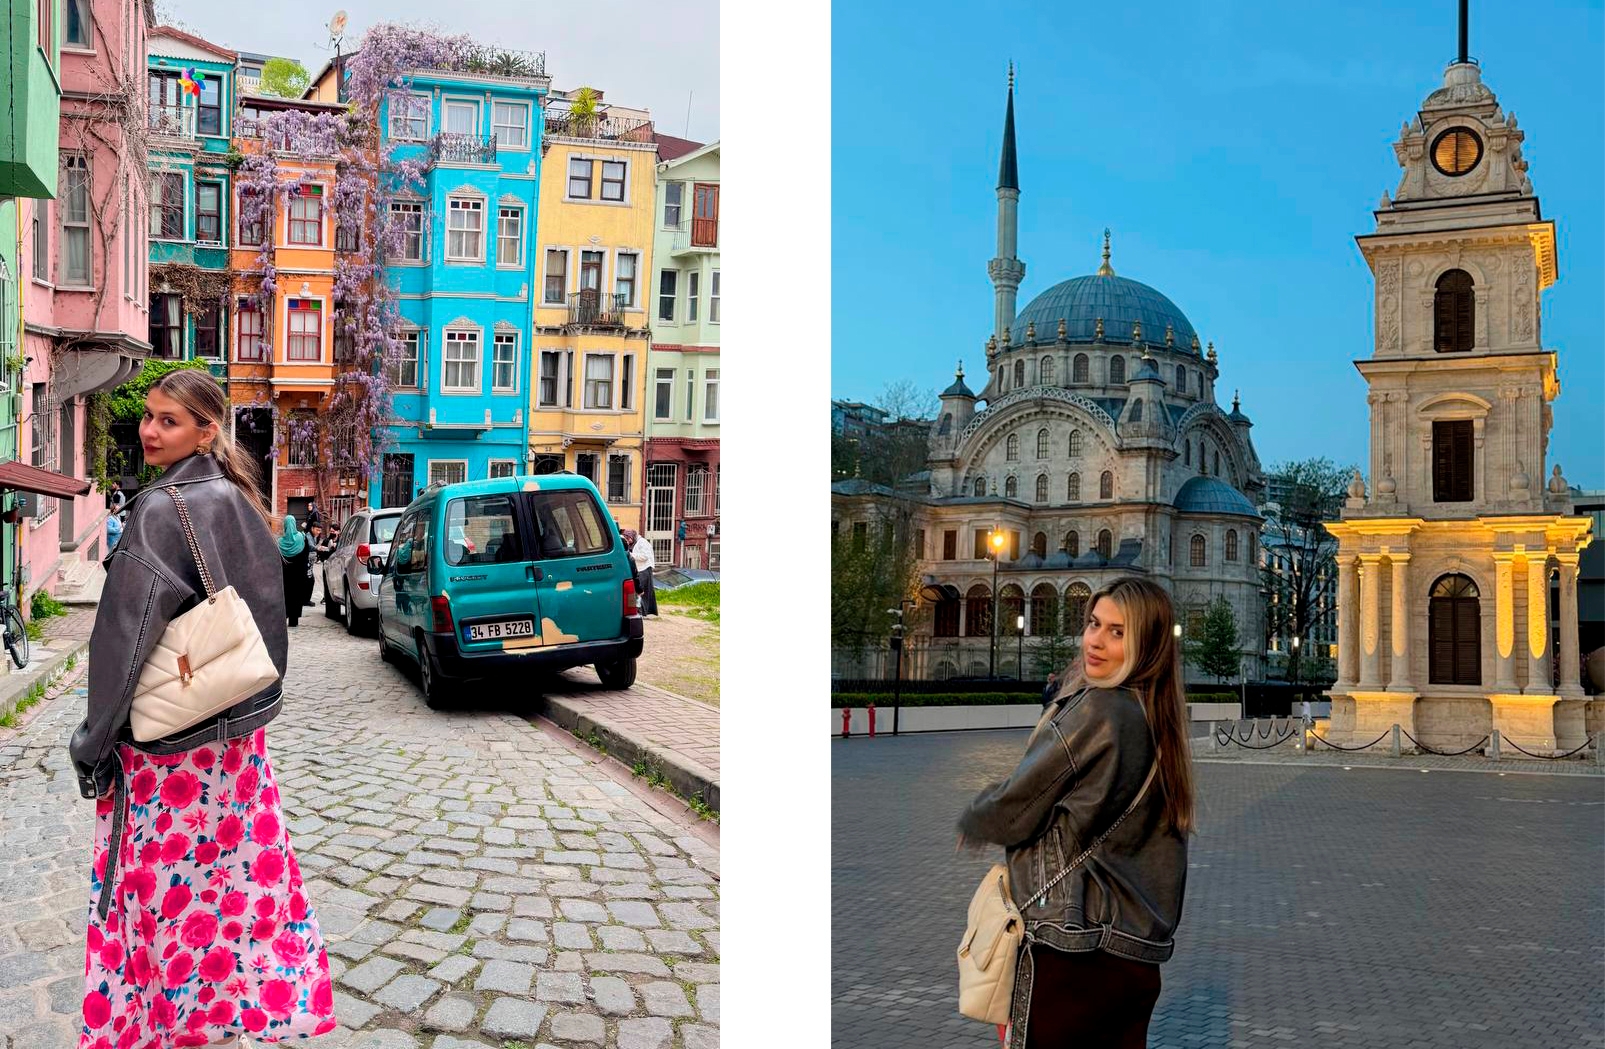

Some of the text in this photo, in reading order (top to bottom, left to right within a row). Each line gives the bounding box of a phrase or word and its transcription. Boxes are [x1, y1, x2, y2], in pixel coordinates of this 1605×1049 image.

[471, 621, 531, 639] 34 FB 5228
